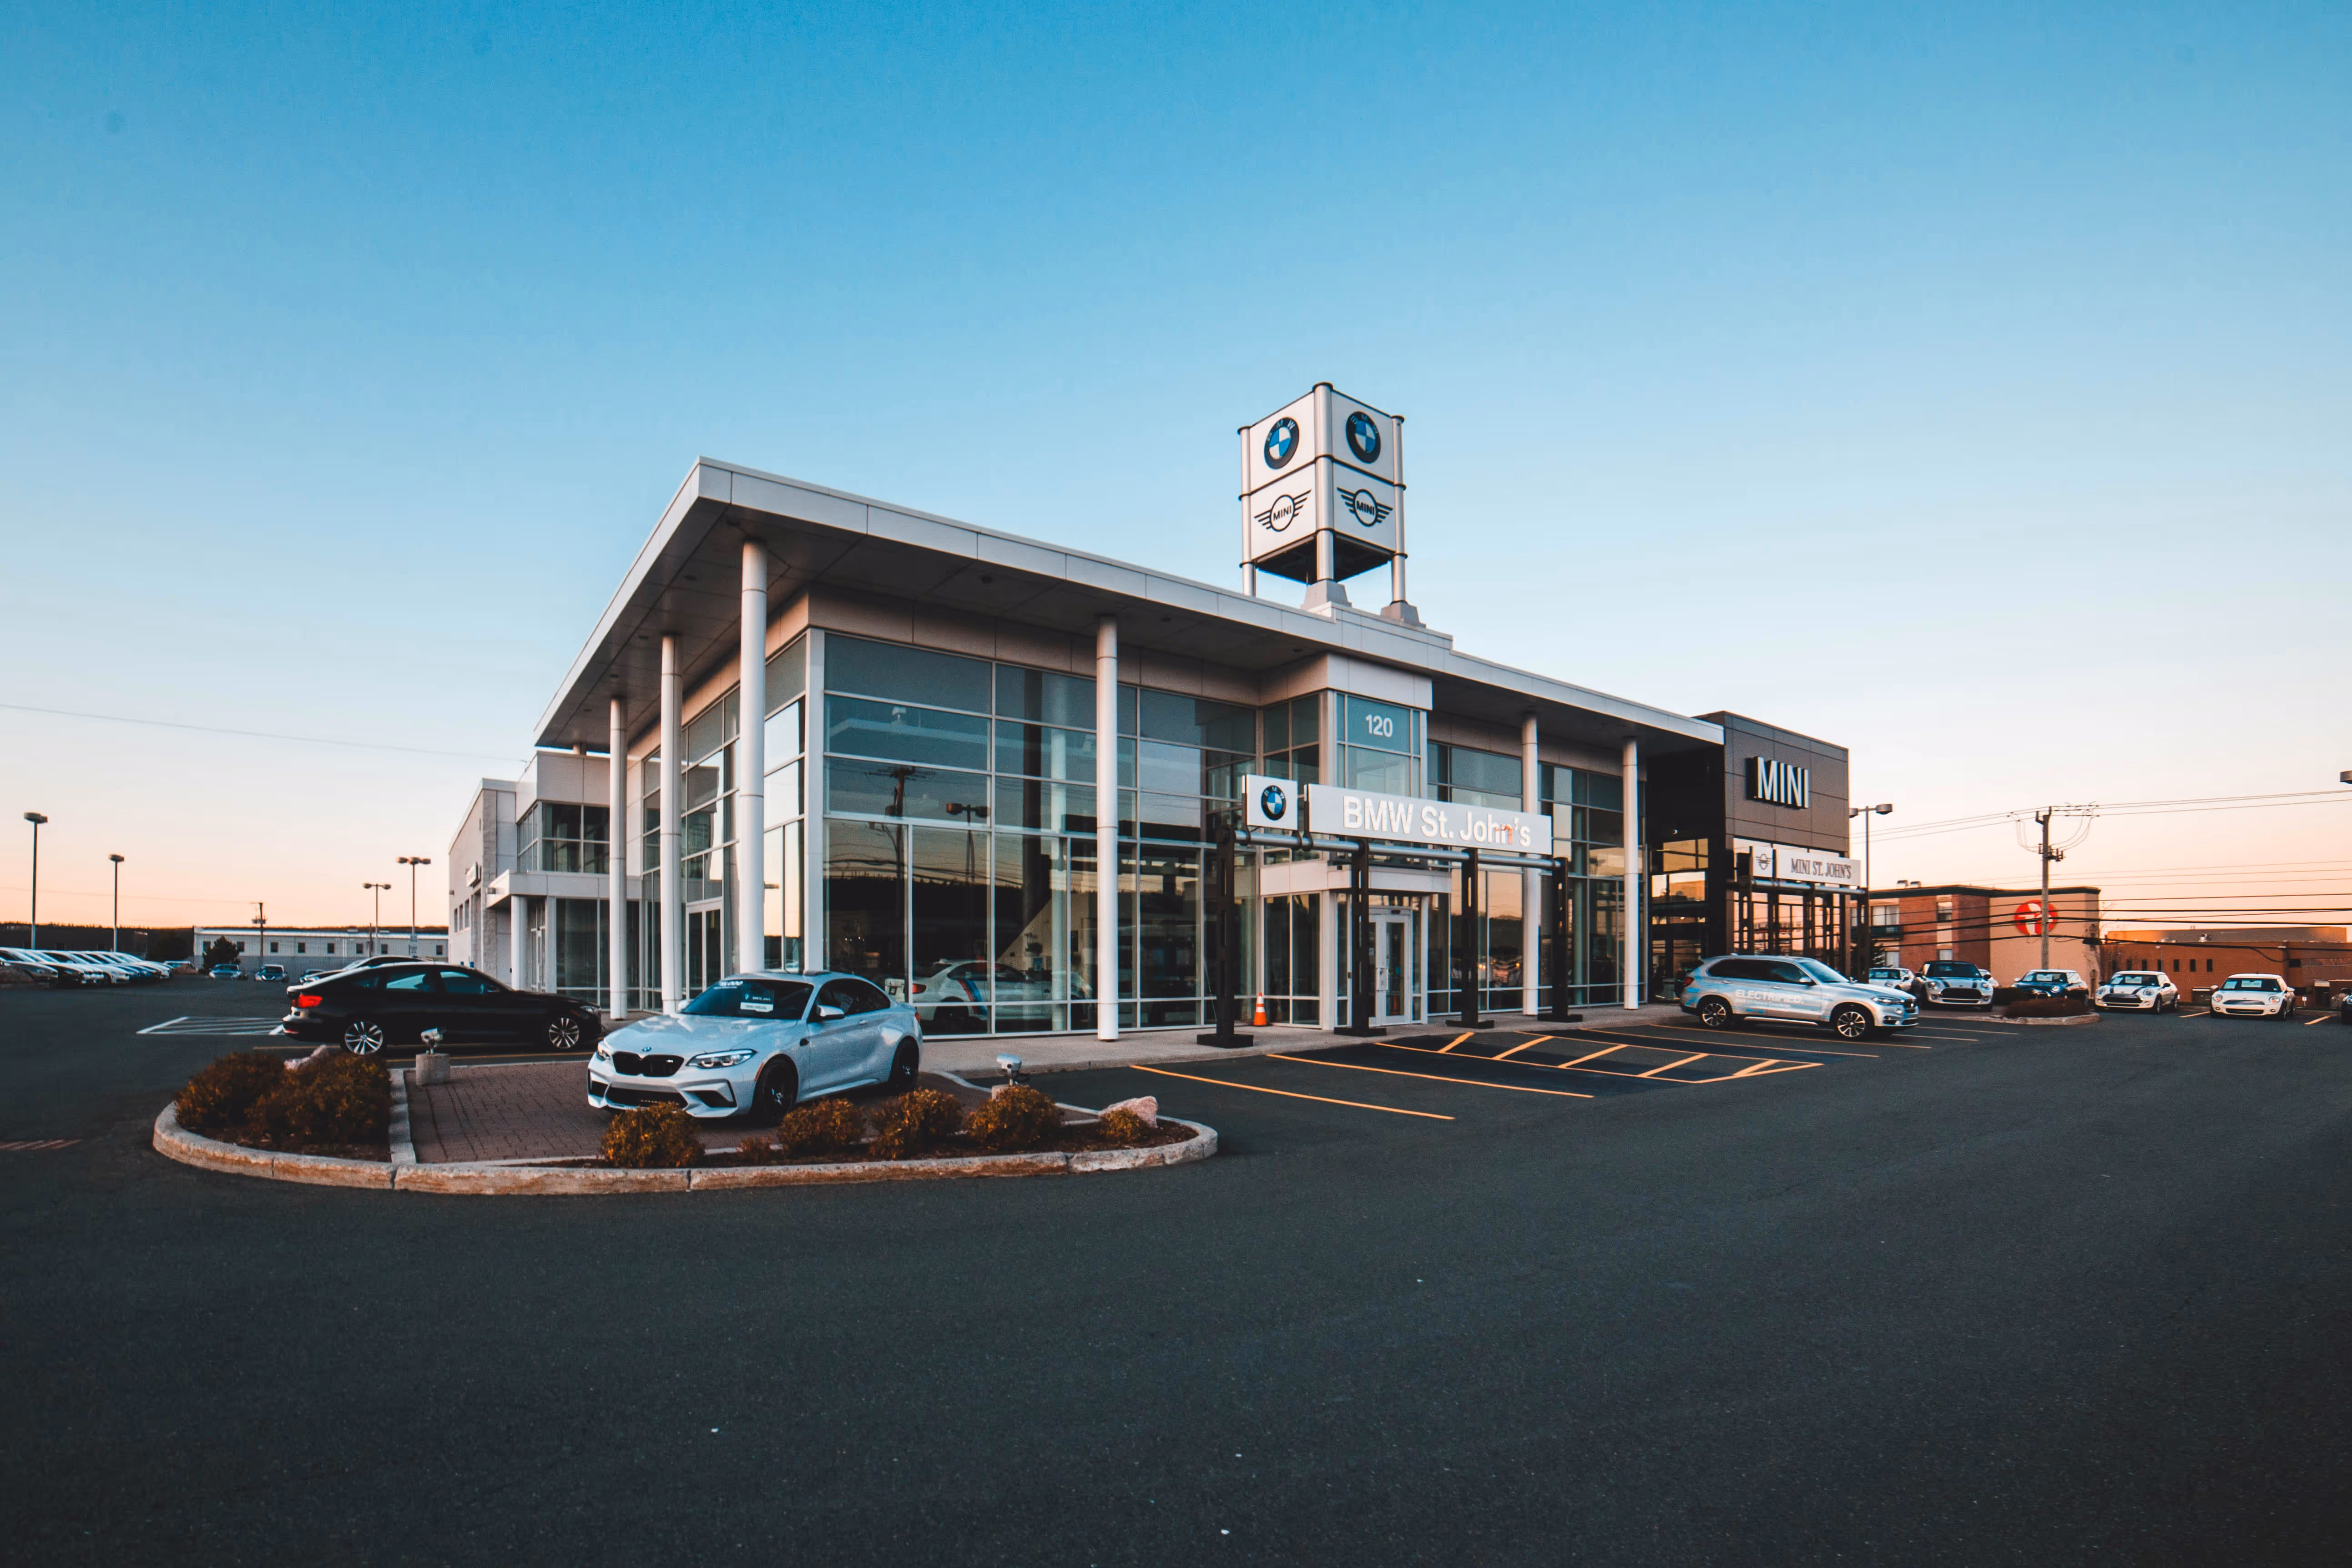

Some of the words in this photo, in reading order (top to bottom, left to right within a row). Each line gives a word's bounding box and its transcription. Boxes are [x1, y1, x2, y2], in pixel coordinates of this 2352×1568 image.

[1273, 505, 1292, 521] MINI
[1356, 501, 1375, 515] MINI
[1365, 714, 1393, 737] 120
[1756, 756, 1809, 808] MINI
[1343, 795, 1414, 835] BMW
[1420, 805, 1454, 838] St.
[1459, 811, 1531, 847] John's
[1791, 858, 1811, 875] MINI
[1812, 861, 1824, 876] ST.
[1825, 862, 1852, 879] JOHN'S
